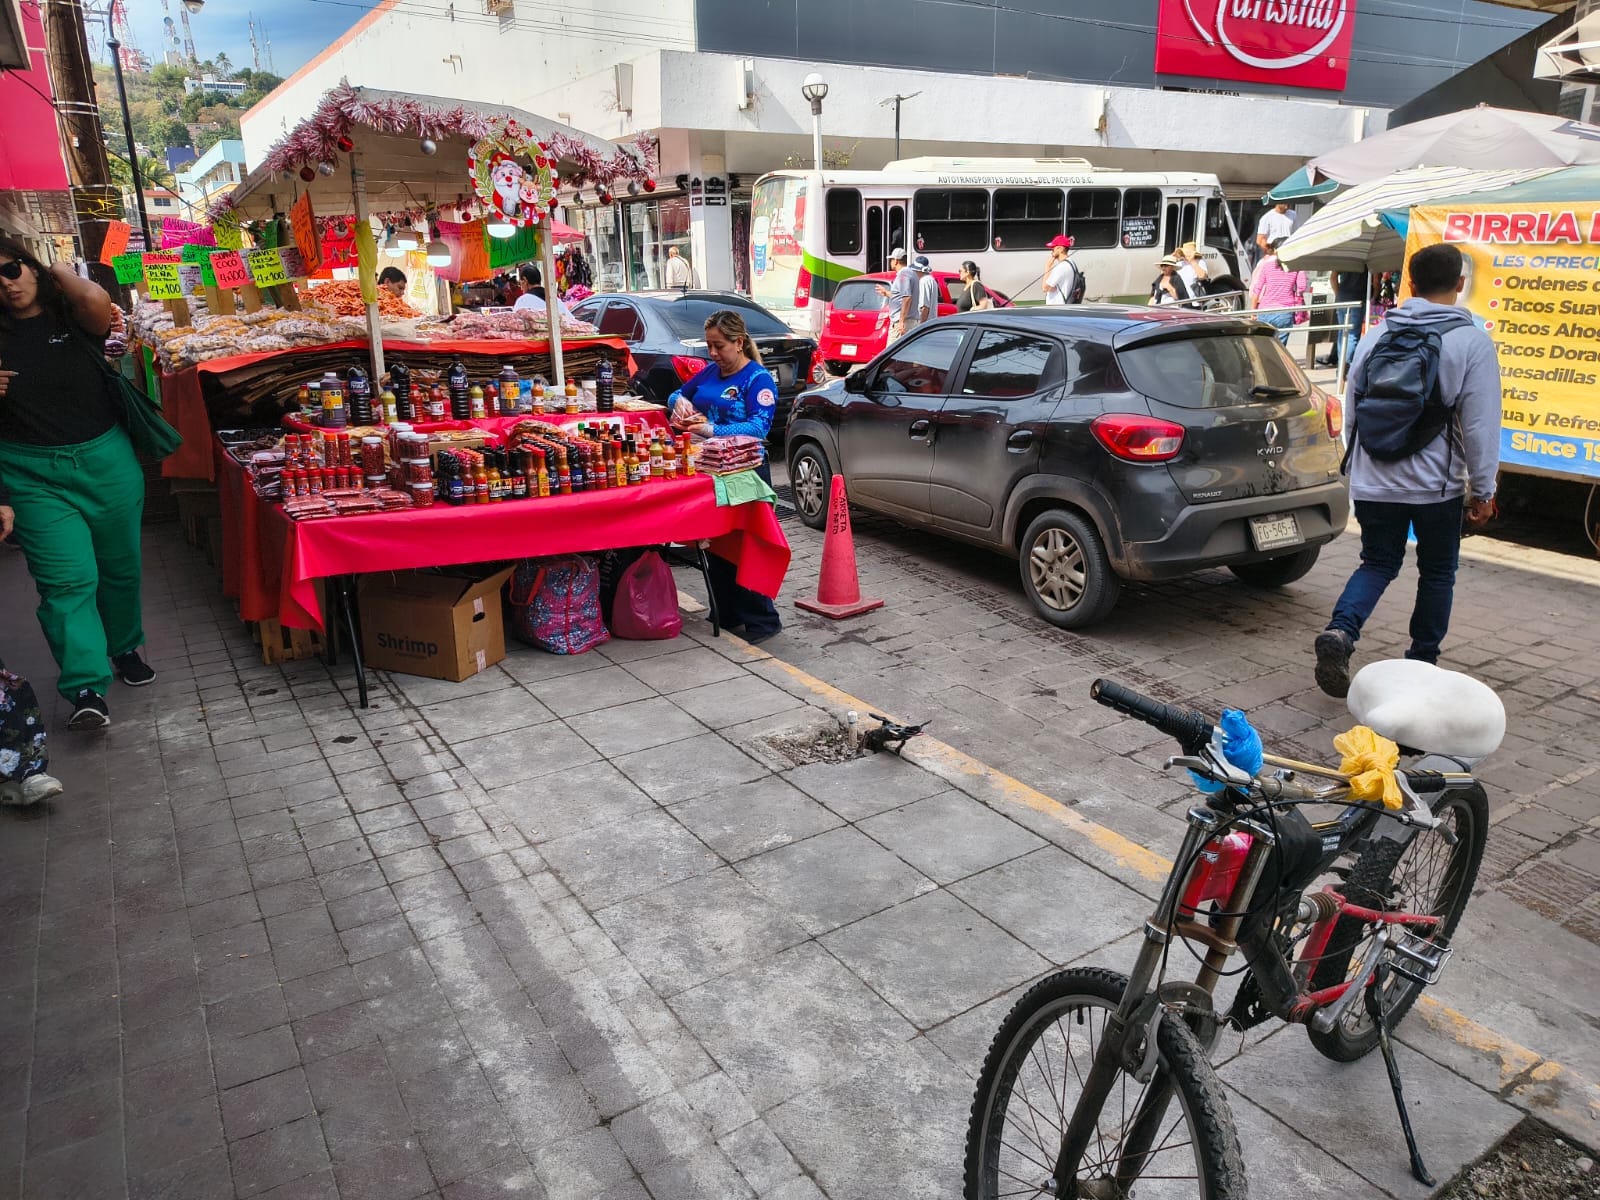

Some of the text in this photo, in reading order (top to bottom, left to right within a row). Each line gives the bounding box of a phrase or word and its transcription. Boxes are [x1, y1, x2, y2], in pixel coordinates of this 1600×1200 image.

[1231, 0, 1333, 30] arisina
[938, 176, 1004, 184] AUTOTRANSPORTES
[1005, 176, 1034, 184] AGUILAS
[1443, 212, 1581, 243] BIRRIA
[1493, 255, 1526, 267] LES
[1505, 275, 1588, 292] Ordenes
[1502, 297, 1555, 313] Tacos
[1498, 319, 1550, 336] Tacos
[1494, 341, 1600, 362] Tacos Dora
[1500, 366, 1598, 385] uesadillas
[1502, 386, 1539, 402] rtas
[1528, 412, 1541, 427] y
[1544, 412, 1600, 432] Refre
[1256, 446, 1284, 456] KWID
[1510, 431, 1578, 459] Since
[377, 632, 438, 658] Shrimp
